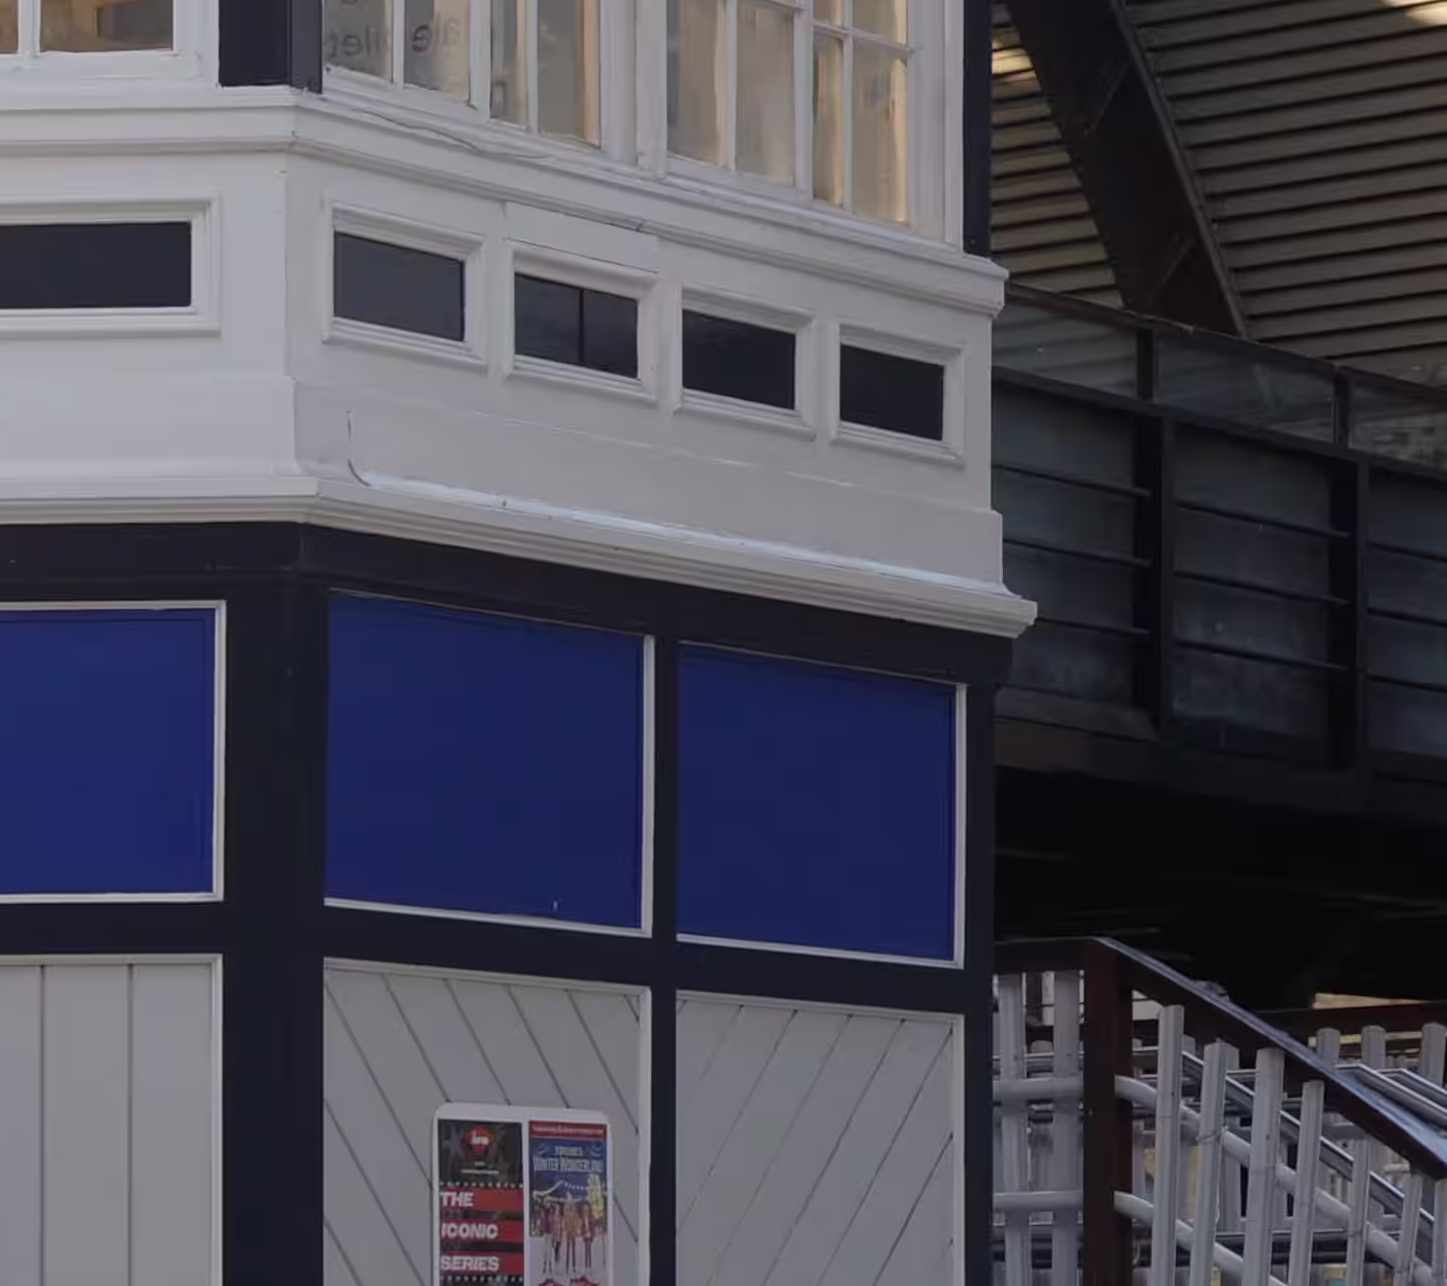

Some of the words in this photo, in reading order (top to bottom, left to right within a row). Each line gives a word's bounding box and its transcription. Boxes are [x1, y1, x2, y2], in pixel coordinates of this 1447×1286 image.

[440, 1191, 474, 1207] THE
[442, 1223, 499, 1240] ICONIC
[440, 1255, 500, 1272] SERIES
